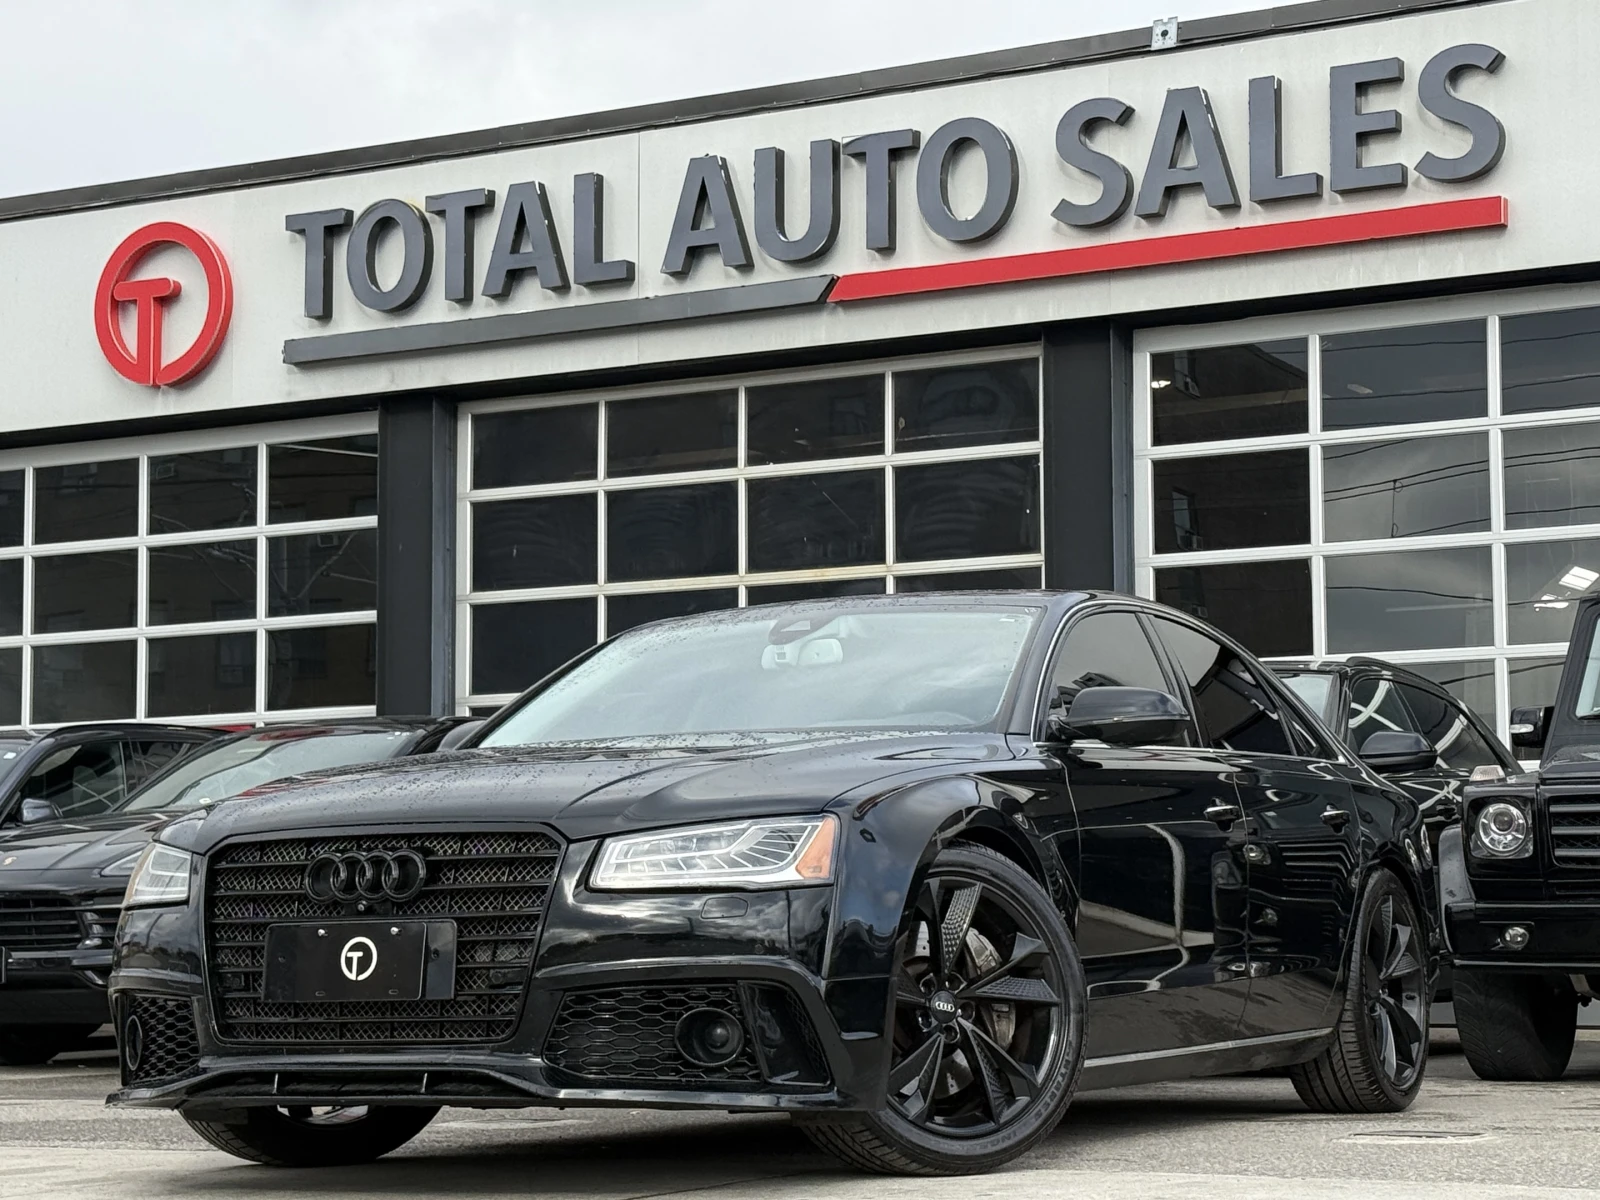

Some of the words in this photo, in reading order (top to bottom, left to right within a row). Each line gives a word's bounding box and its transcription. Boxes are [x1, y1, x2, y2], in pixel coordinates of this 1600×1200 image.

[285, 172, 636, 320] TOTAL
[660, 117, 1019, 273] AUTO
[1050, 44, 1506, 227] SALES
